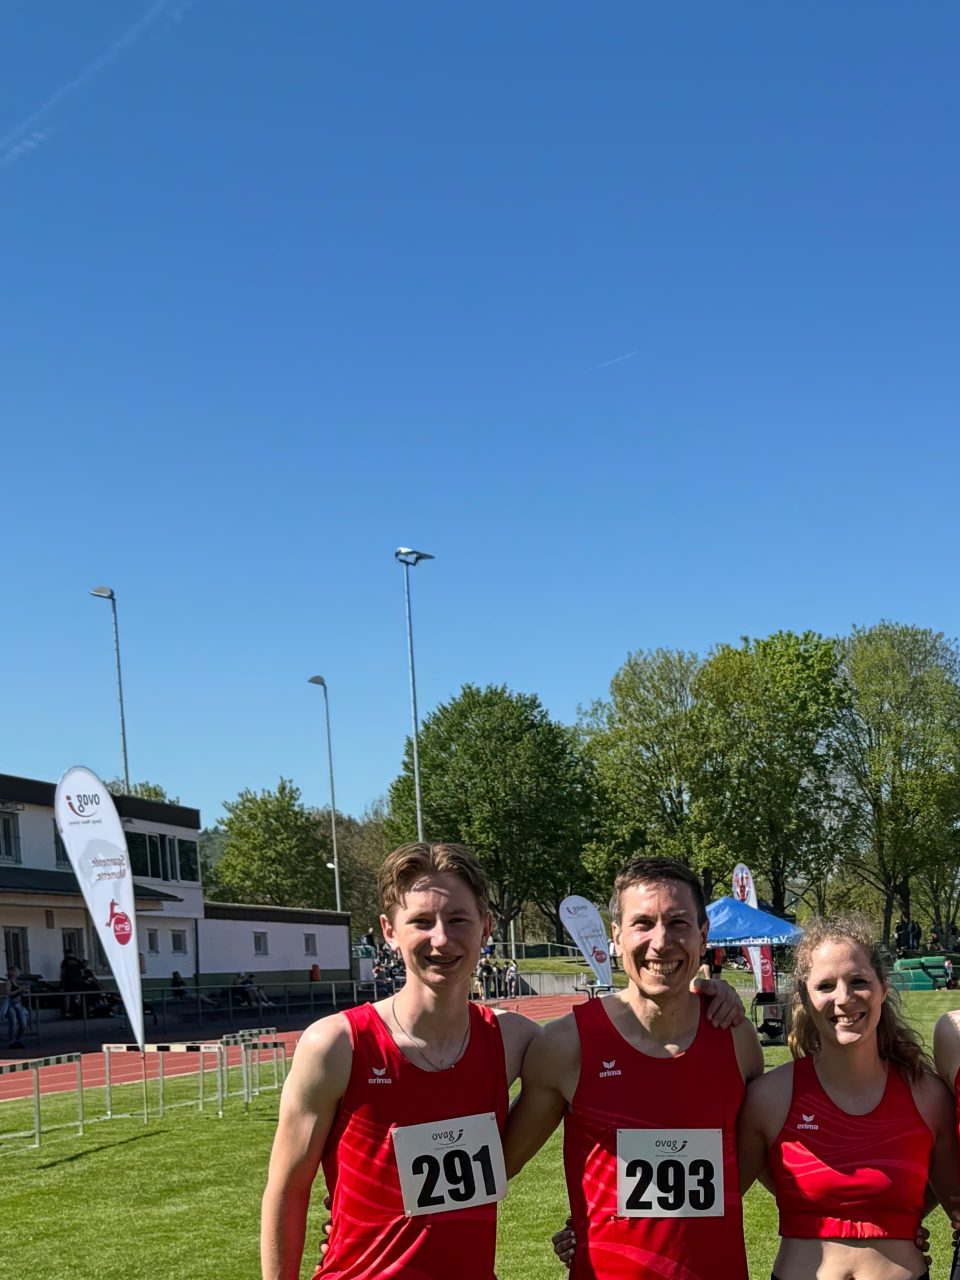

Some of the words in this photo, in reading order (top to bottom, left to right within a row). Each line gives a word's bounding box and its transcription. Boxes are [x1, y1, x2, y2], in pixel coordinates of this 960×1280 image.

[599, 1069, 622, 1078] erima
[432, 1130, 455, 1142] ovag
[655, 1140, 678, 1151] ovag
[411, 1145, 497, 1208] 291
[625, 1159, 716, 1211] 293
